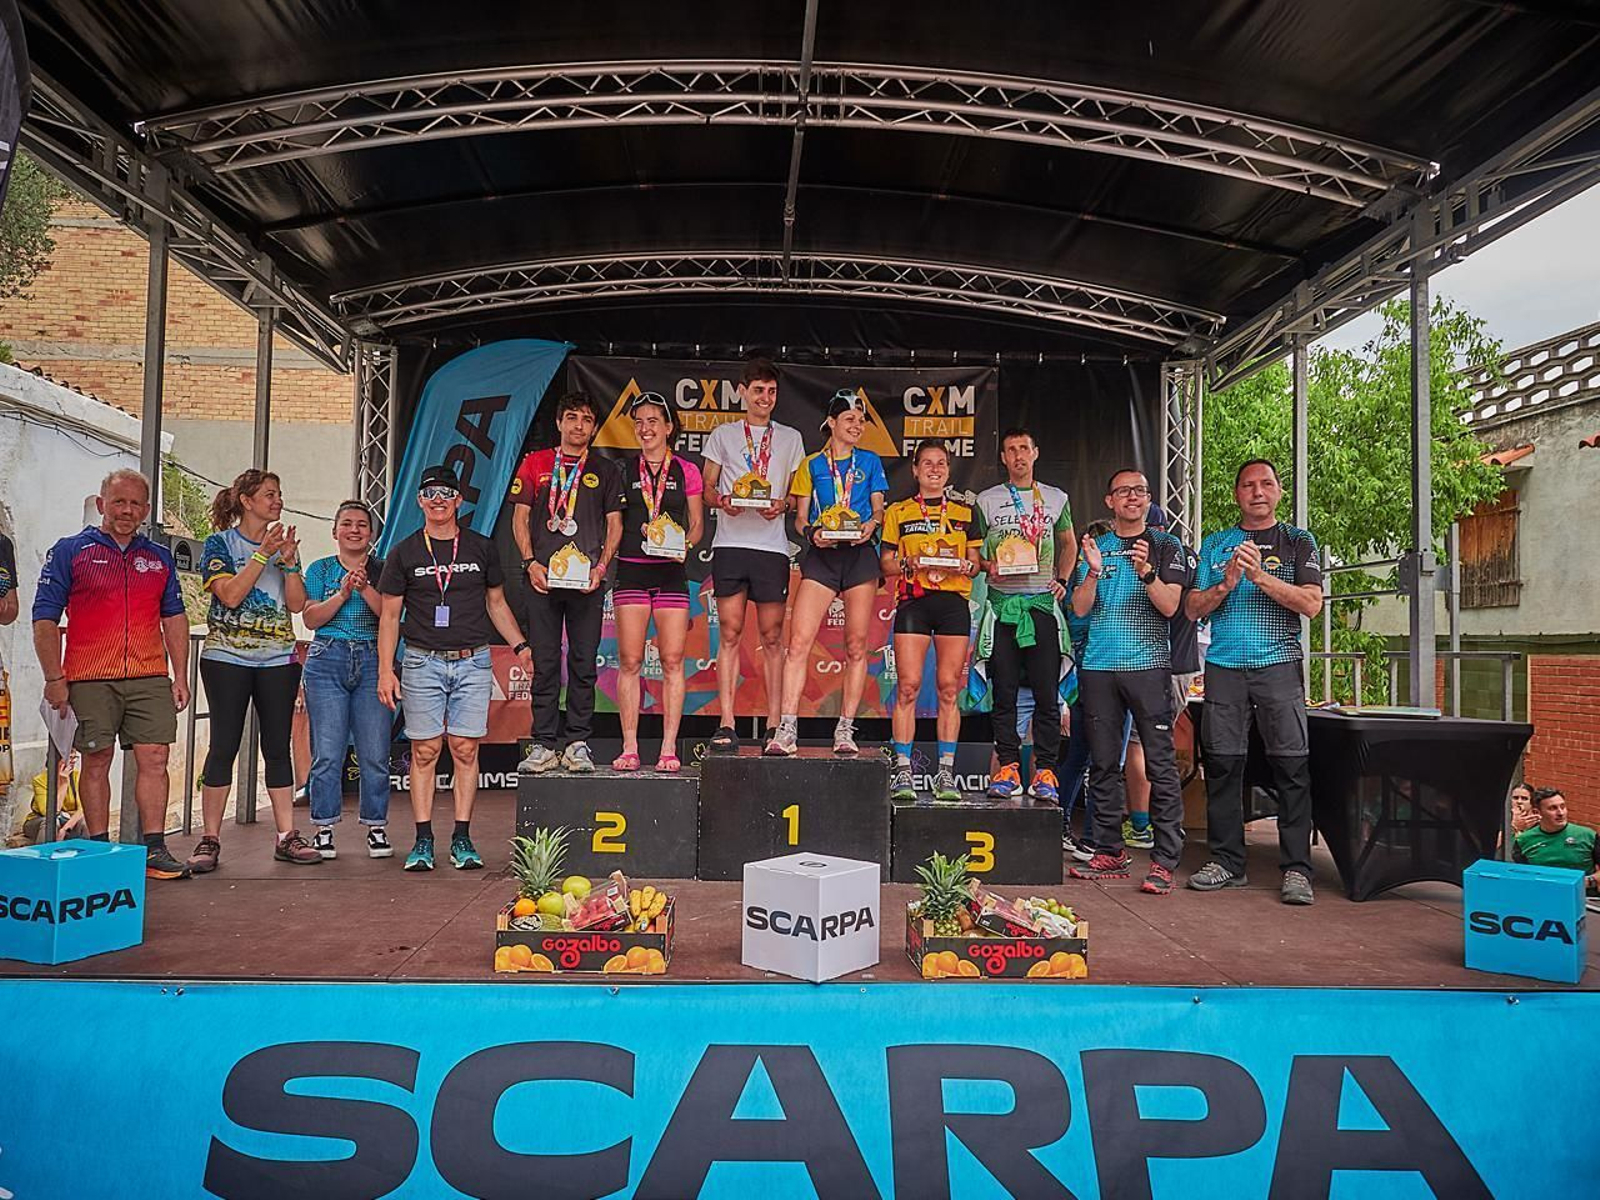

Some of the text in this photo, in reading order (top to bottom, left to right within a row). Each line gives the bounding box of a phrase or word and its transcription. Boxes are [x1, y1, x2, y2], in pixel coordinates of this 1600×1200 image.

[676, 378, 747, 411] CXM
[903, 385, 975, 415] CXM
[910, 419, 969, 436] TRAIL
[902, 438, 975, 457] FME
[414, 562, 481, 577] SCARPA
[508, 691, 531, 701] FED
[591, 811, 627, 853] 2
[782, 804, 800, 846] 1
[965, 831, 995, 873] 3
[746, 905, 875, 942] SCARPA
[1469, 911, 1575, 945] SCA
[204, 1040, 1494, 1200] SCARPA
